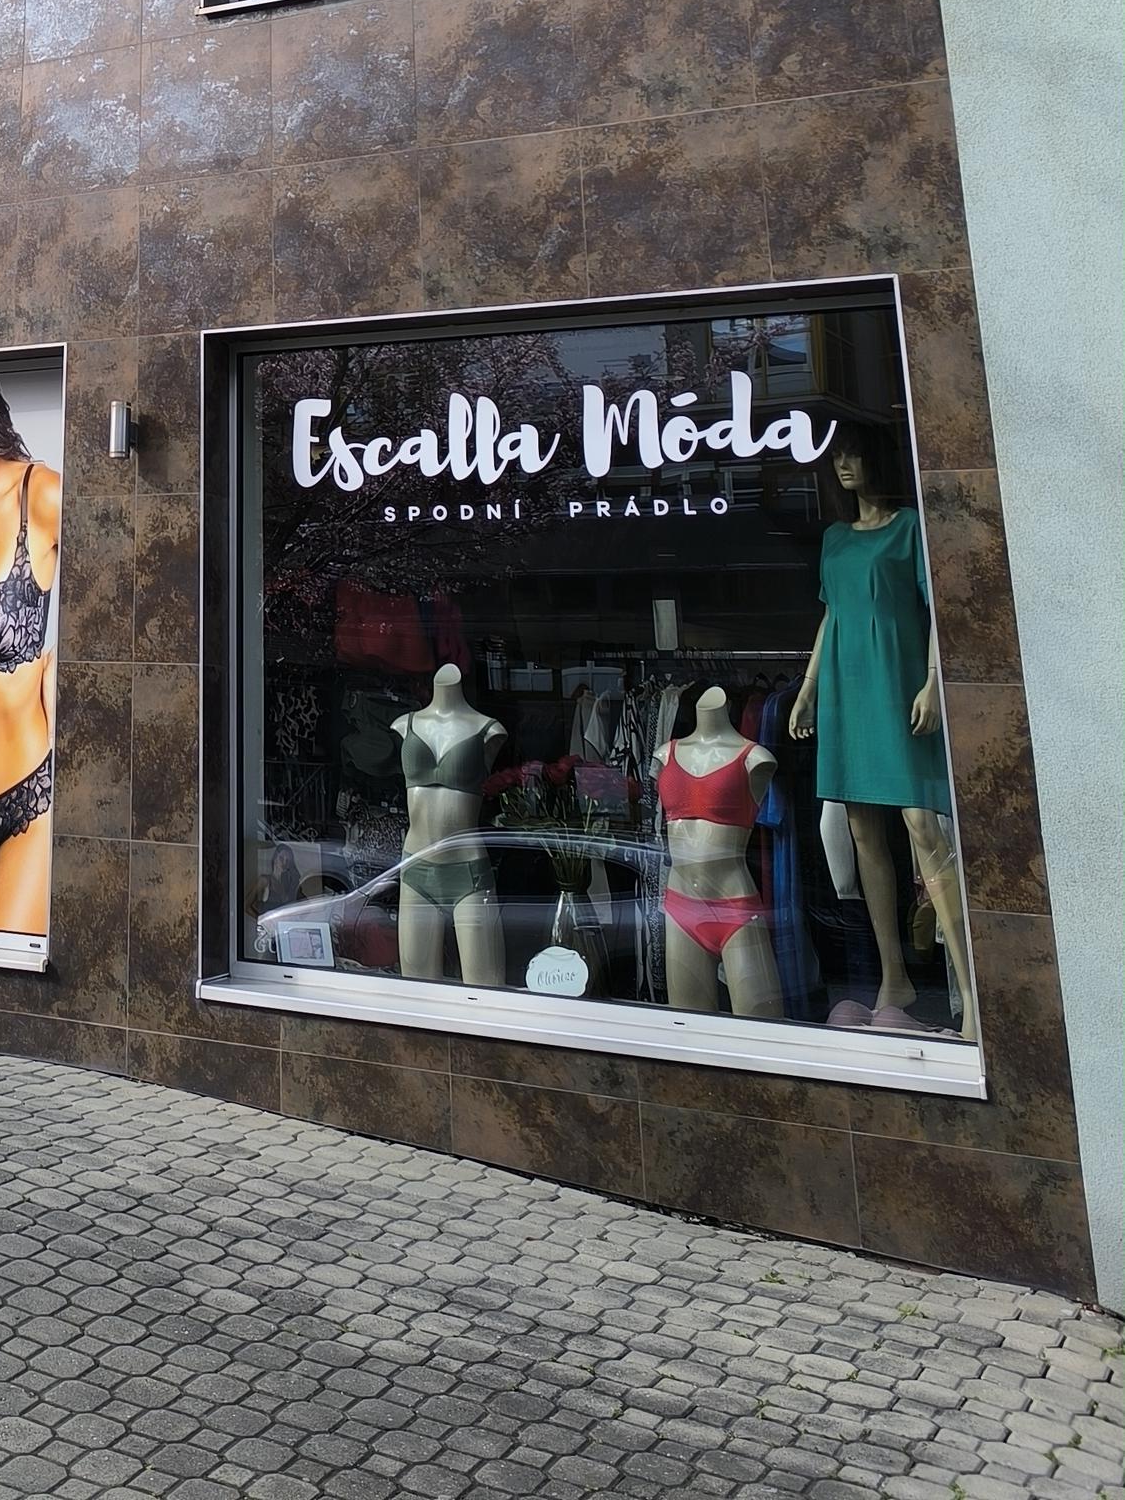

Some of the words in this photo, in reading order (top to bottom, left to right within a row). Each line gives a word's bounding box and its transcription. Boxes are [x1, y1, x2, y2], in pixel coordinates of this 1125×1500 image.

[292, 392, 561, 492] Escalla
[583, 370, 838, 478] Móda
[385, 499, 521, 522] SPODNÍ
[570, 495, 729, 519] PRÁDLO
